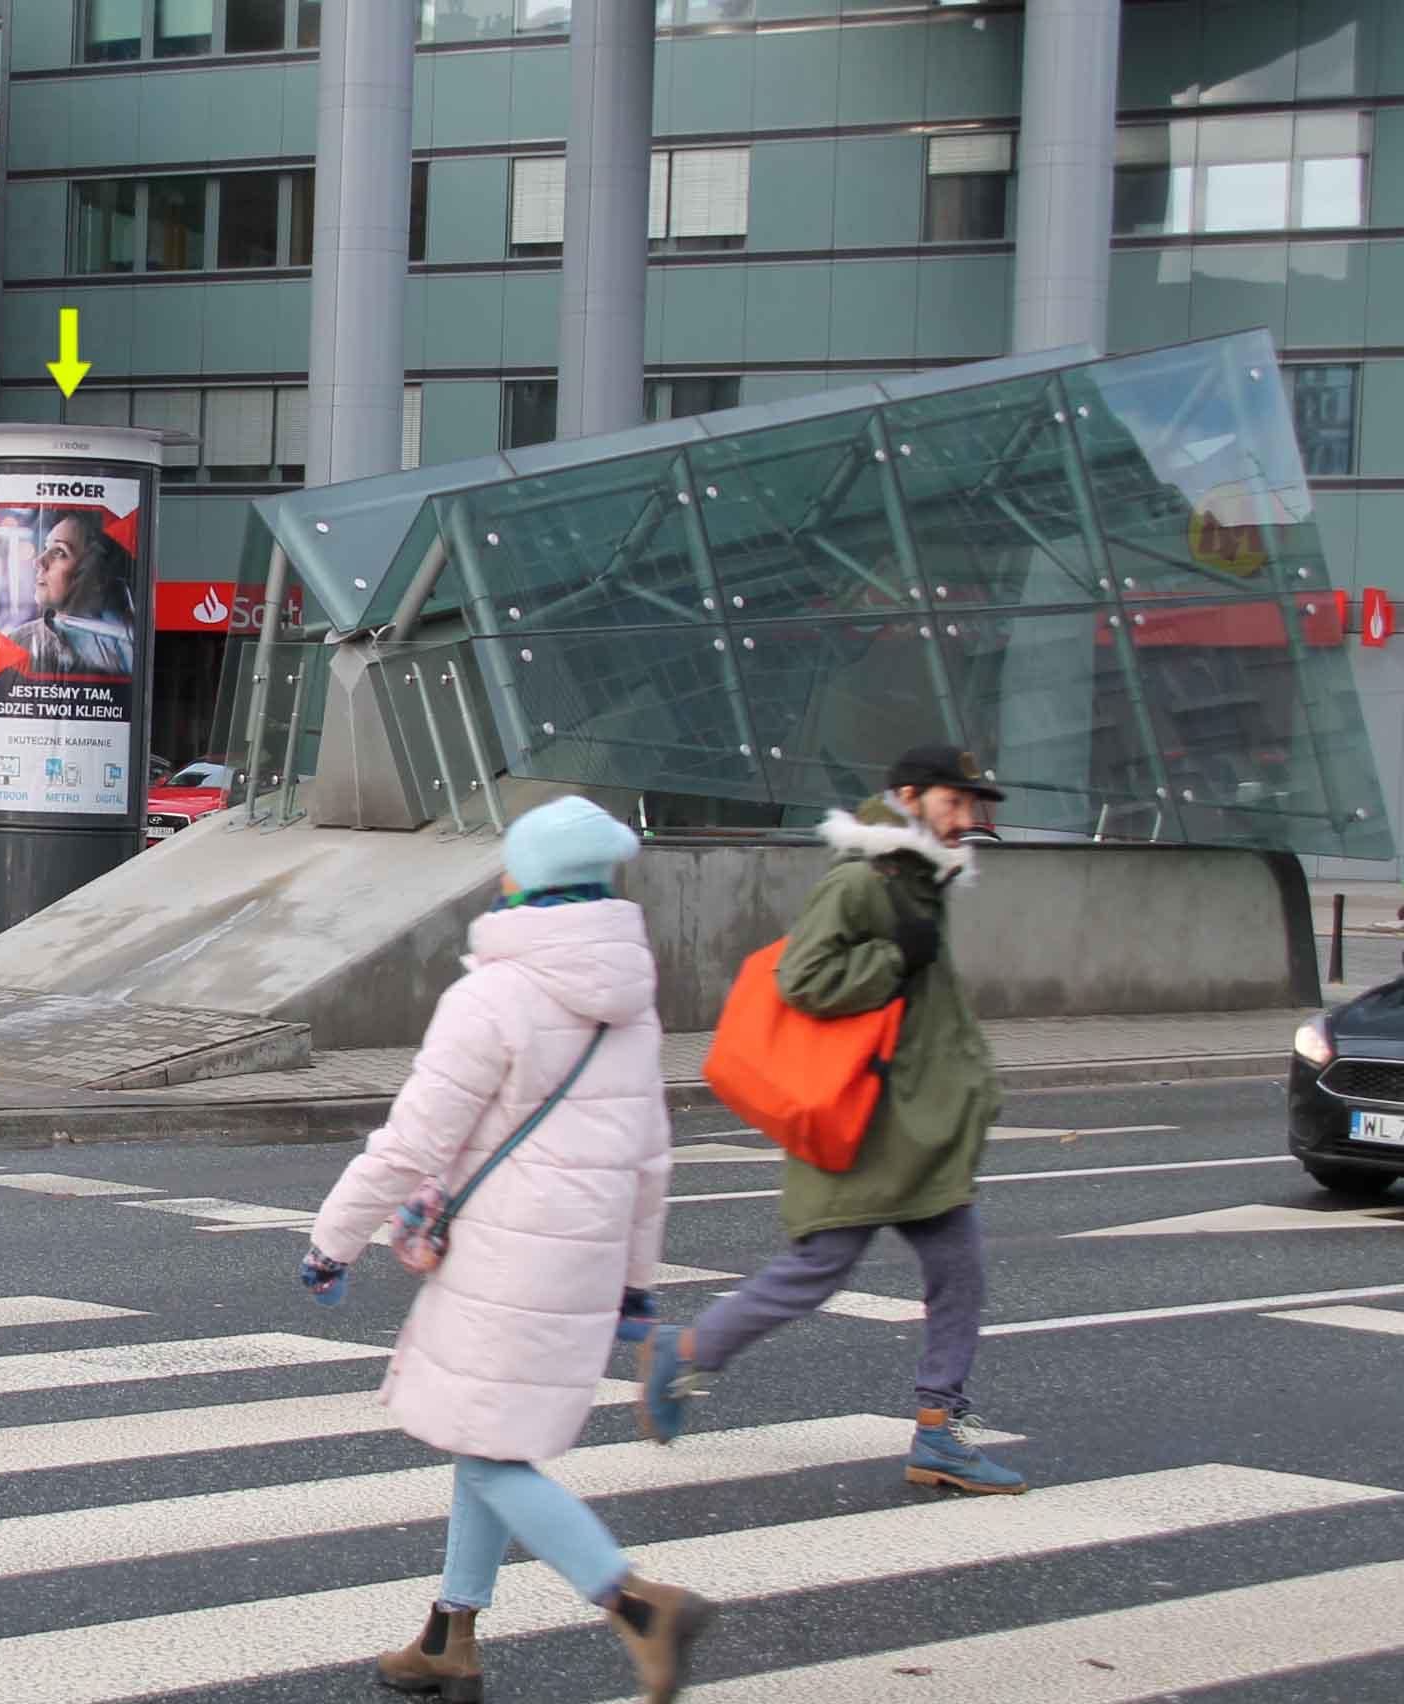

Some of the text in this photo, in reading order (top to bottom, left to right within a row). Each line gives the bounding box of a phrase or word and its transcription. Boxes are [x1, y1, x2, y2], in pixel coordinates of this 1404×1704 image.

[8, 684, 114, 702] JESTEŚMY TAM,
[37, 703, 72, 717] TWOI
[76, 705, 123, 719] KLIENCI
[8, 735, 113, 748] SKUTECZNE KAMPANIE
[45, 791, 81, 802] METRO
[1363, 1115, 1391, 1138] WL
